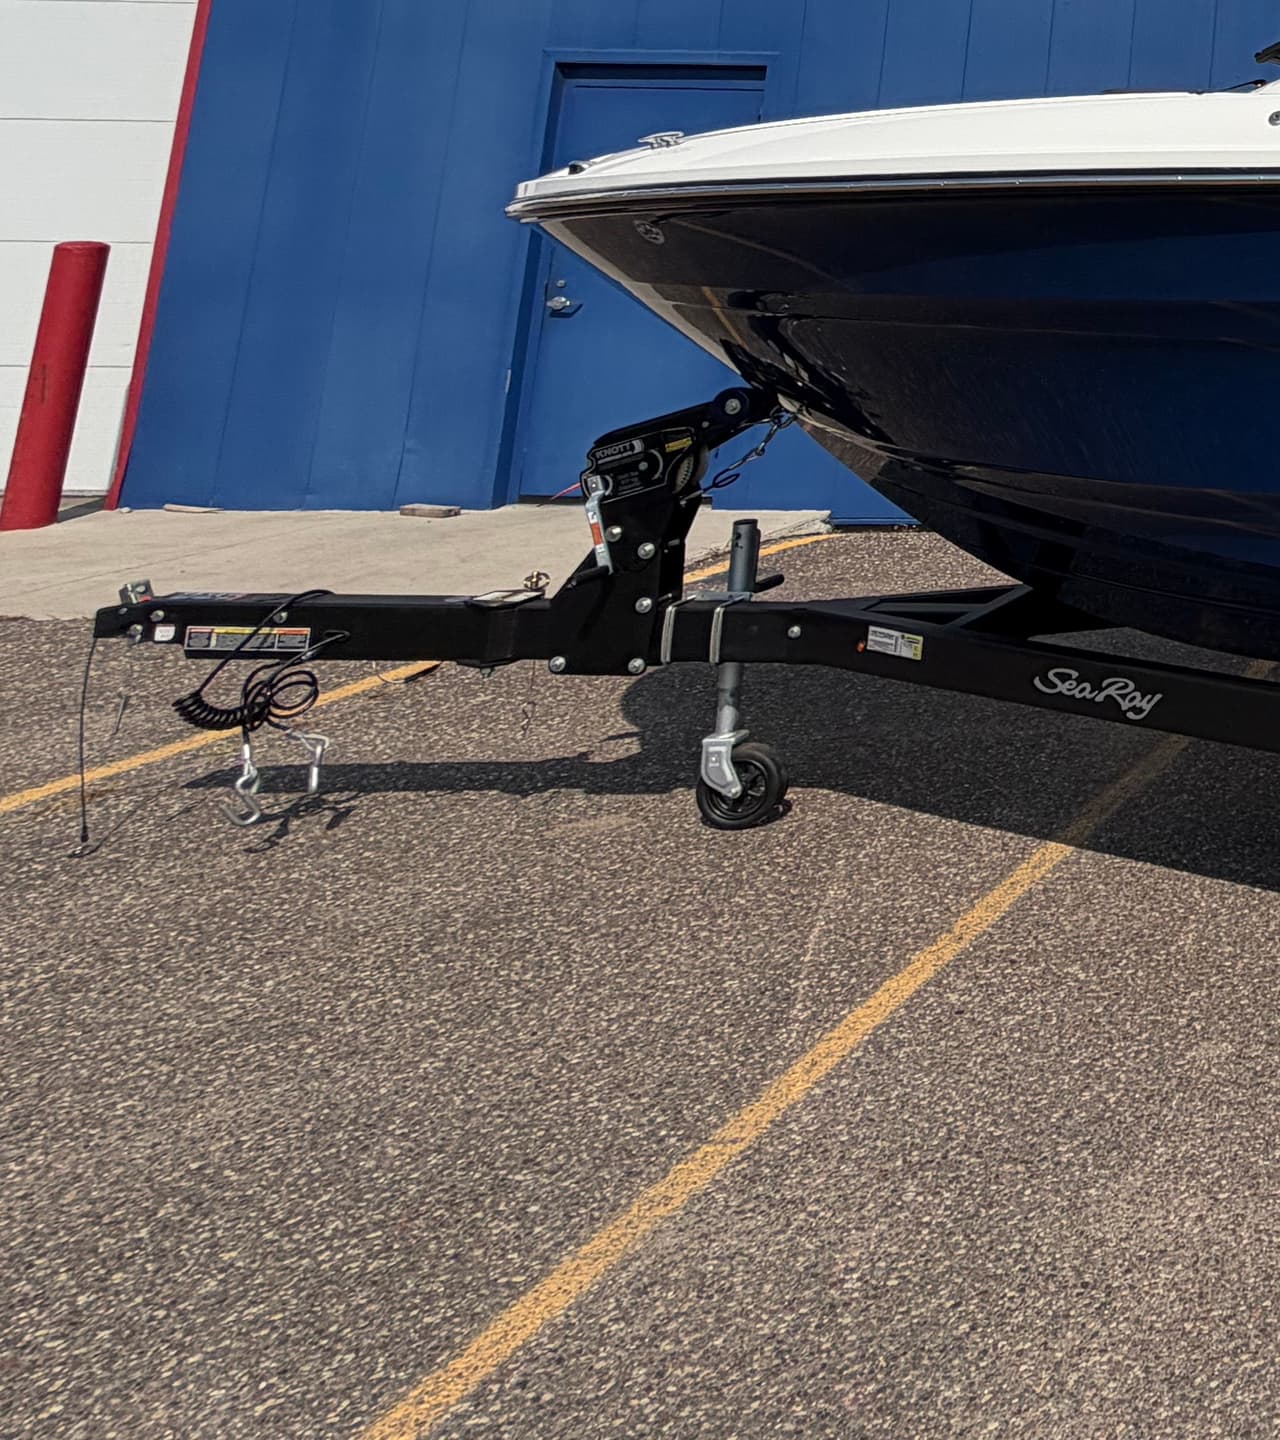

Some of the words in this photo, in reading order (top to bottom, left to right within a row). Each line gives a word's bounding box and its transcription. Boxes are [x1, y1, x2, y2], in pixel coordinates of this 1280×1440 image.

[595, 442, 632, 459] KNOTT
[1033, 668, 1098, 700] Sea
[1094, 677, 1163, 720] Ray
